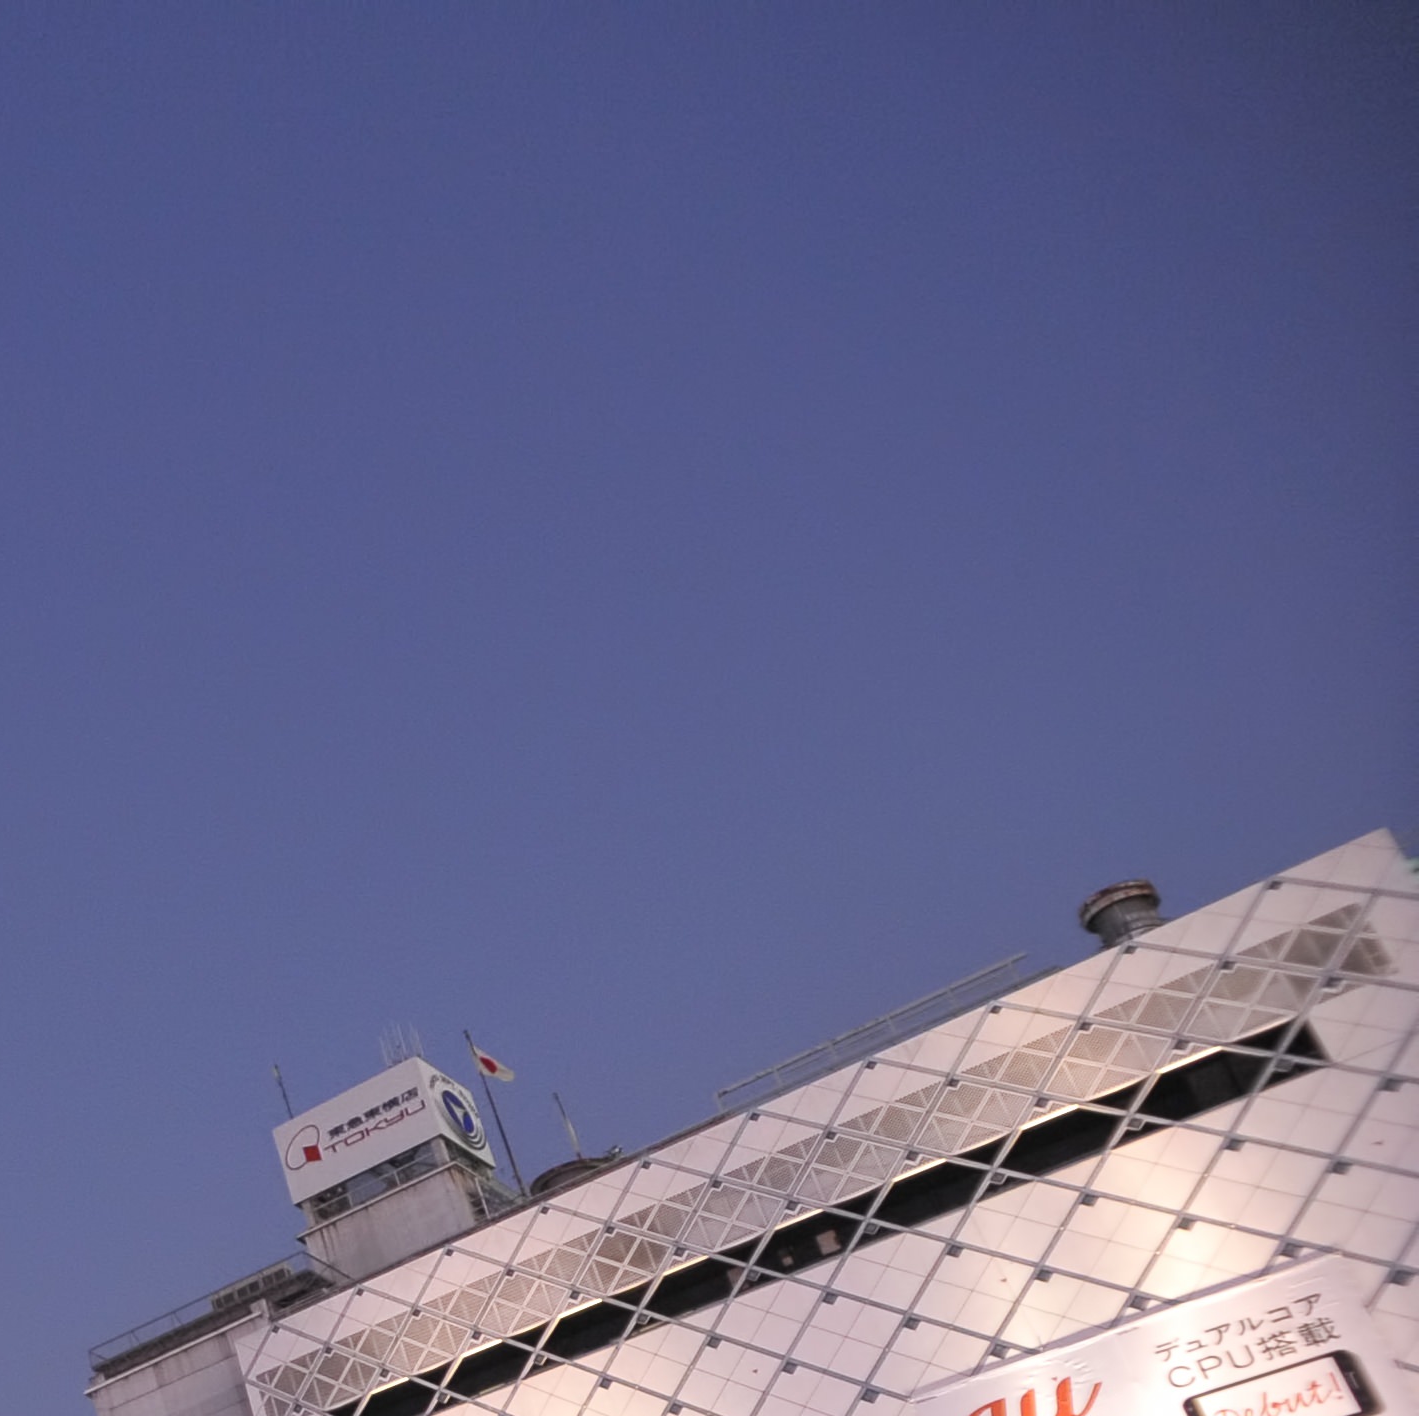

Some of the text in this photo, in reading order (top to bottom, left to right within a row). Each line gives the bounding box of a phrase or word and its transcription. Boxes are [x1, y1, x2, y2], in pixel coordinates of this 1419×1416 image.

[323, 1098, 427, 1154] TOKYU
[1155, 1293, 1322, 1362] デュアルコア
[1168, 1317, 1342, 1388] CPU搭載
